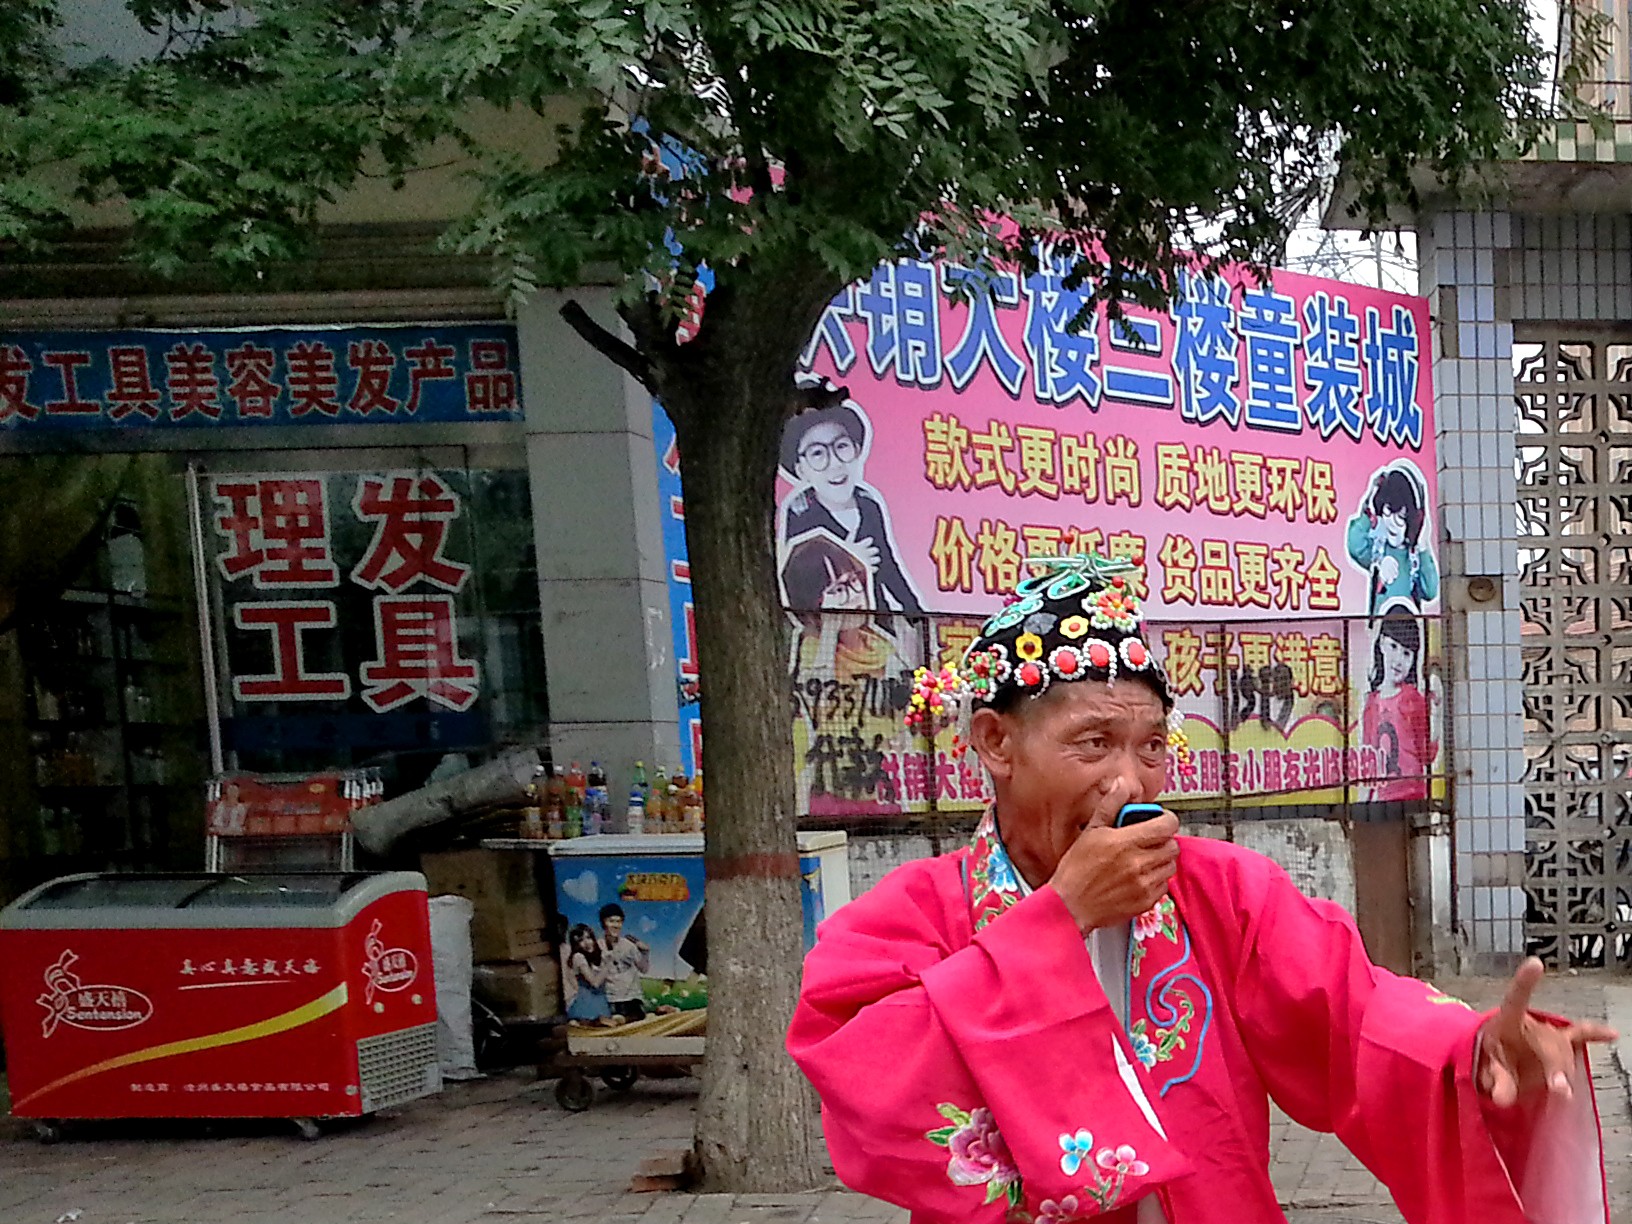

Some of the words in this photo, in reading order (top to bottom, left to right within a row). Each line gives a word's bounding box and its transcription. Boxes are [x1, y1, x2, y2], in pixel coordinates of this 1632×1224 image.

[922, 412, 1141, 506] 款式更时尚
[1155, 441, 1339, 524] 质地更环保
[210, 468, 472, 594] 理发
[1159, 534, 1341, 611] 货品更齐全
[232, 594, 481, 714] 工具
[1162, 628, 1345, 698] 孩子更满意
